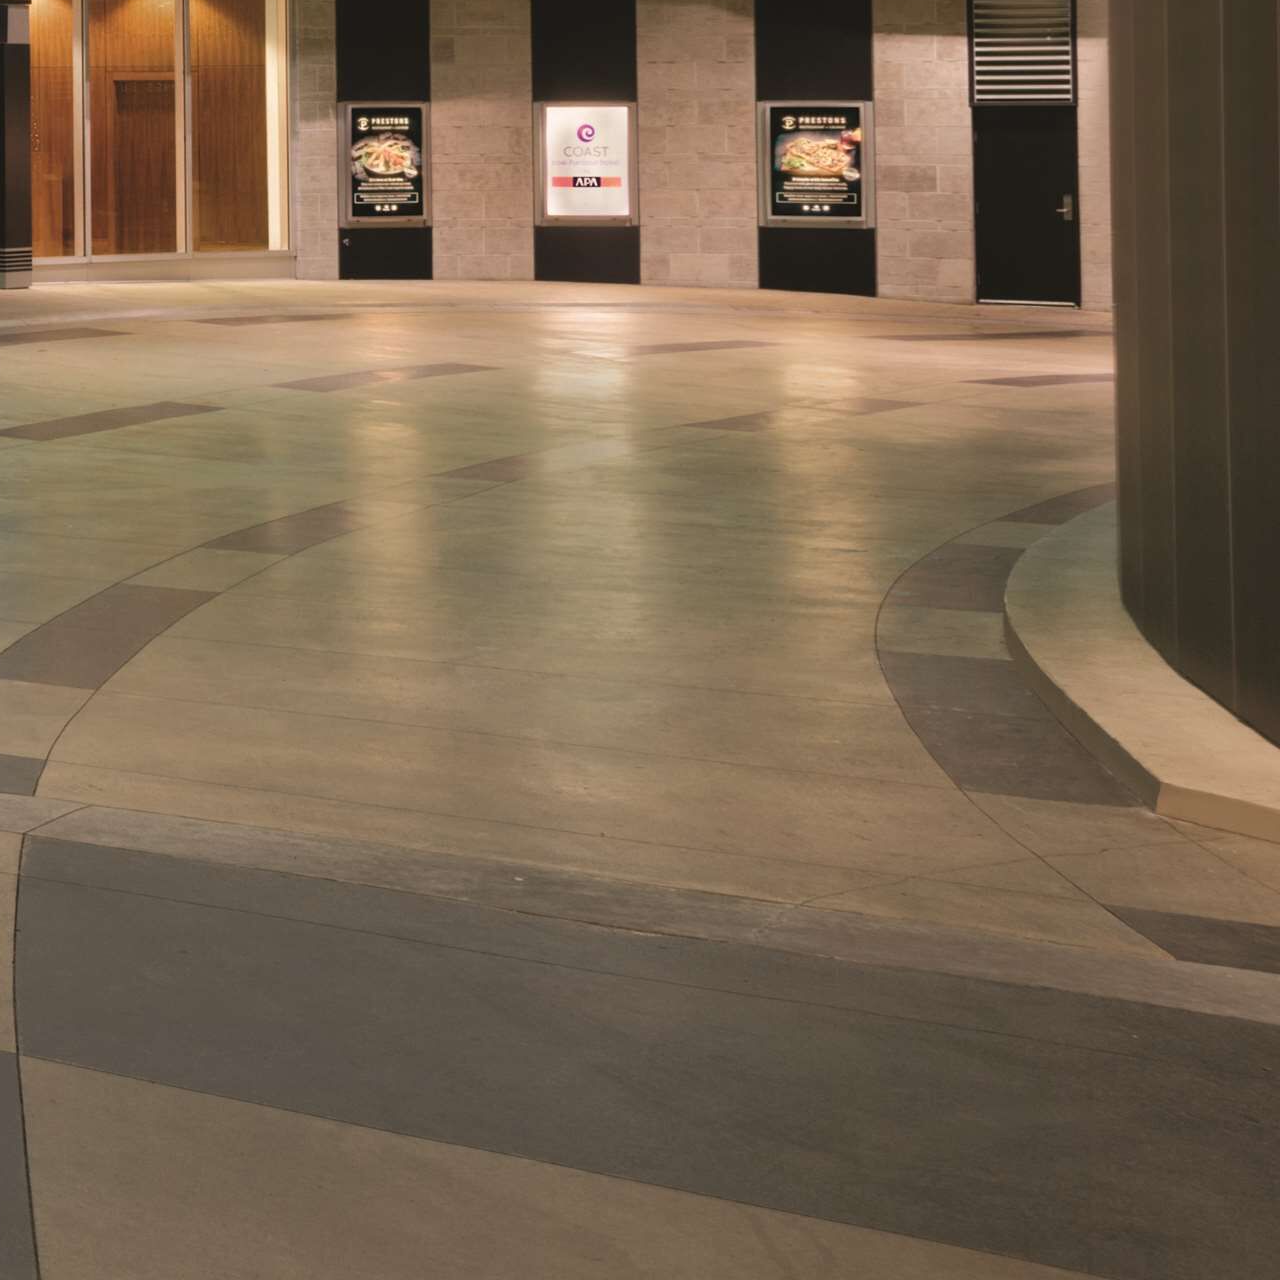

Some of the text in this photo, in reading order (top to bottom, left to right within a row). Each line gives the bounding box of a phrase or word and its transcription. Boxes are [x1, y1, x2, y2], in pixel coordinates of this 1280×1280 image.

[798, 116, 846, 124] PRESTONS
[562, 146, 609, 158] COAST
[575, 177, 598, 187] APA
